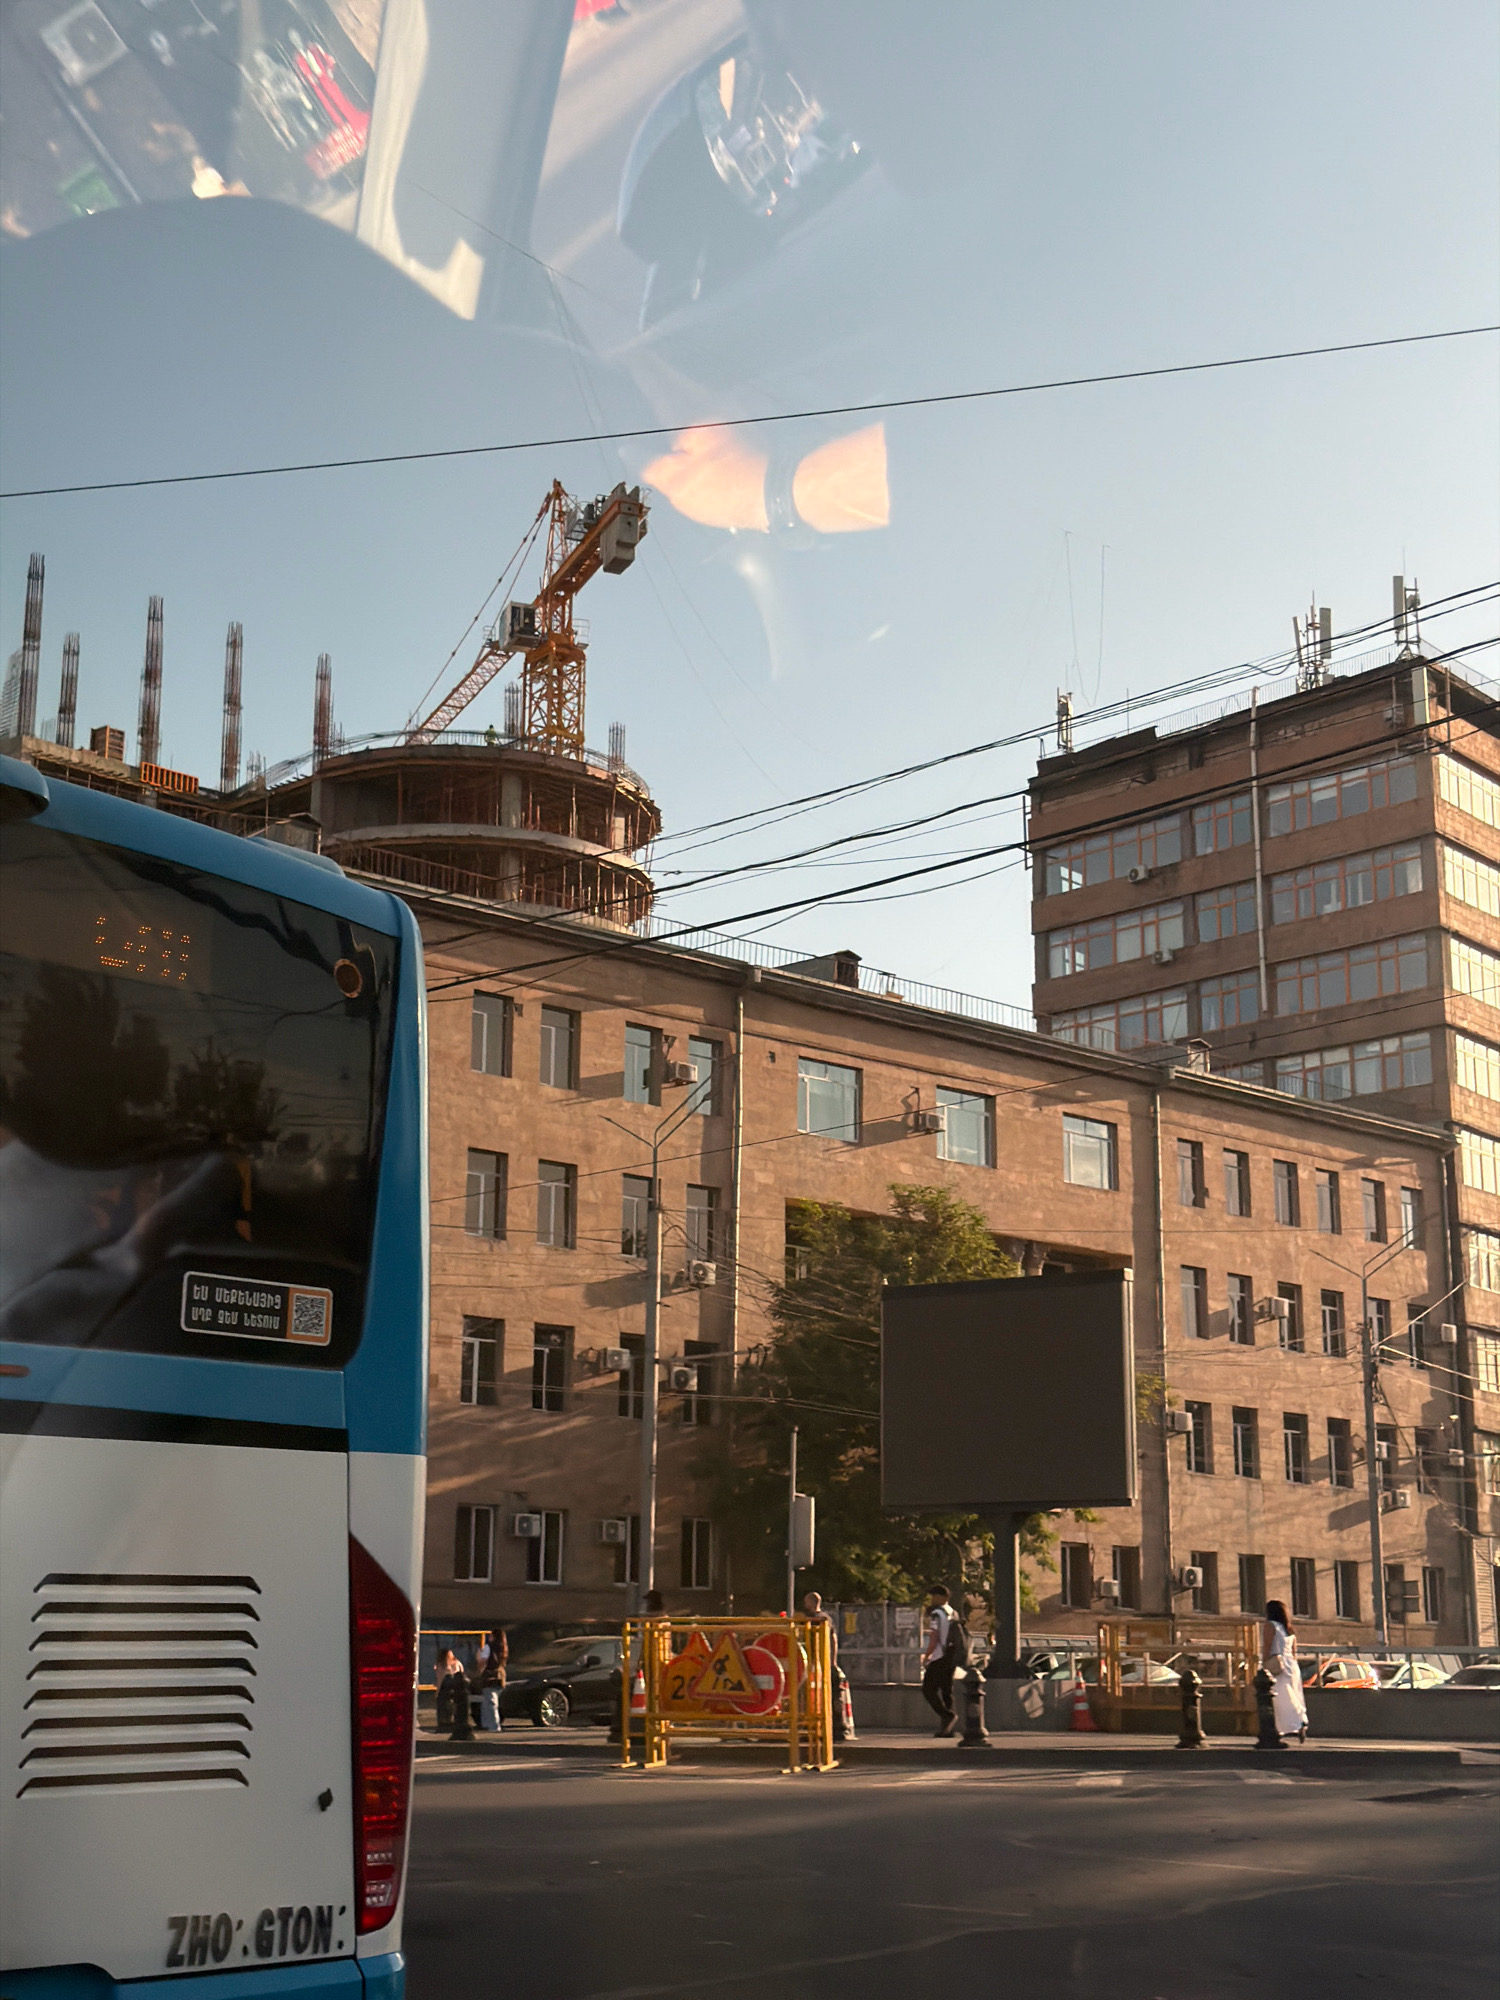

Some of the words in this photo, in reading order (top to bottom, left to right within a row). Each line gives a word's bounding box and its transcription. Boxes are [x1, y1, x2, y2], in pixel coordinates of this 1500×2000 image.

[193, 1284, 209, 1301] ԵՍ
[217, 1309, 239, 1325] ՉԵՄ
[672, 1675, 697, 1700] 2
